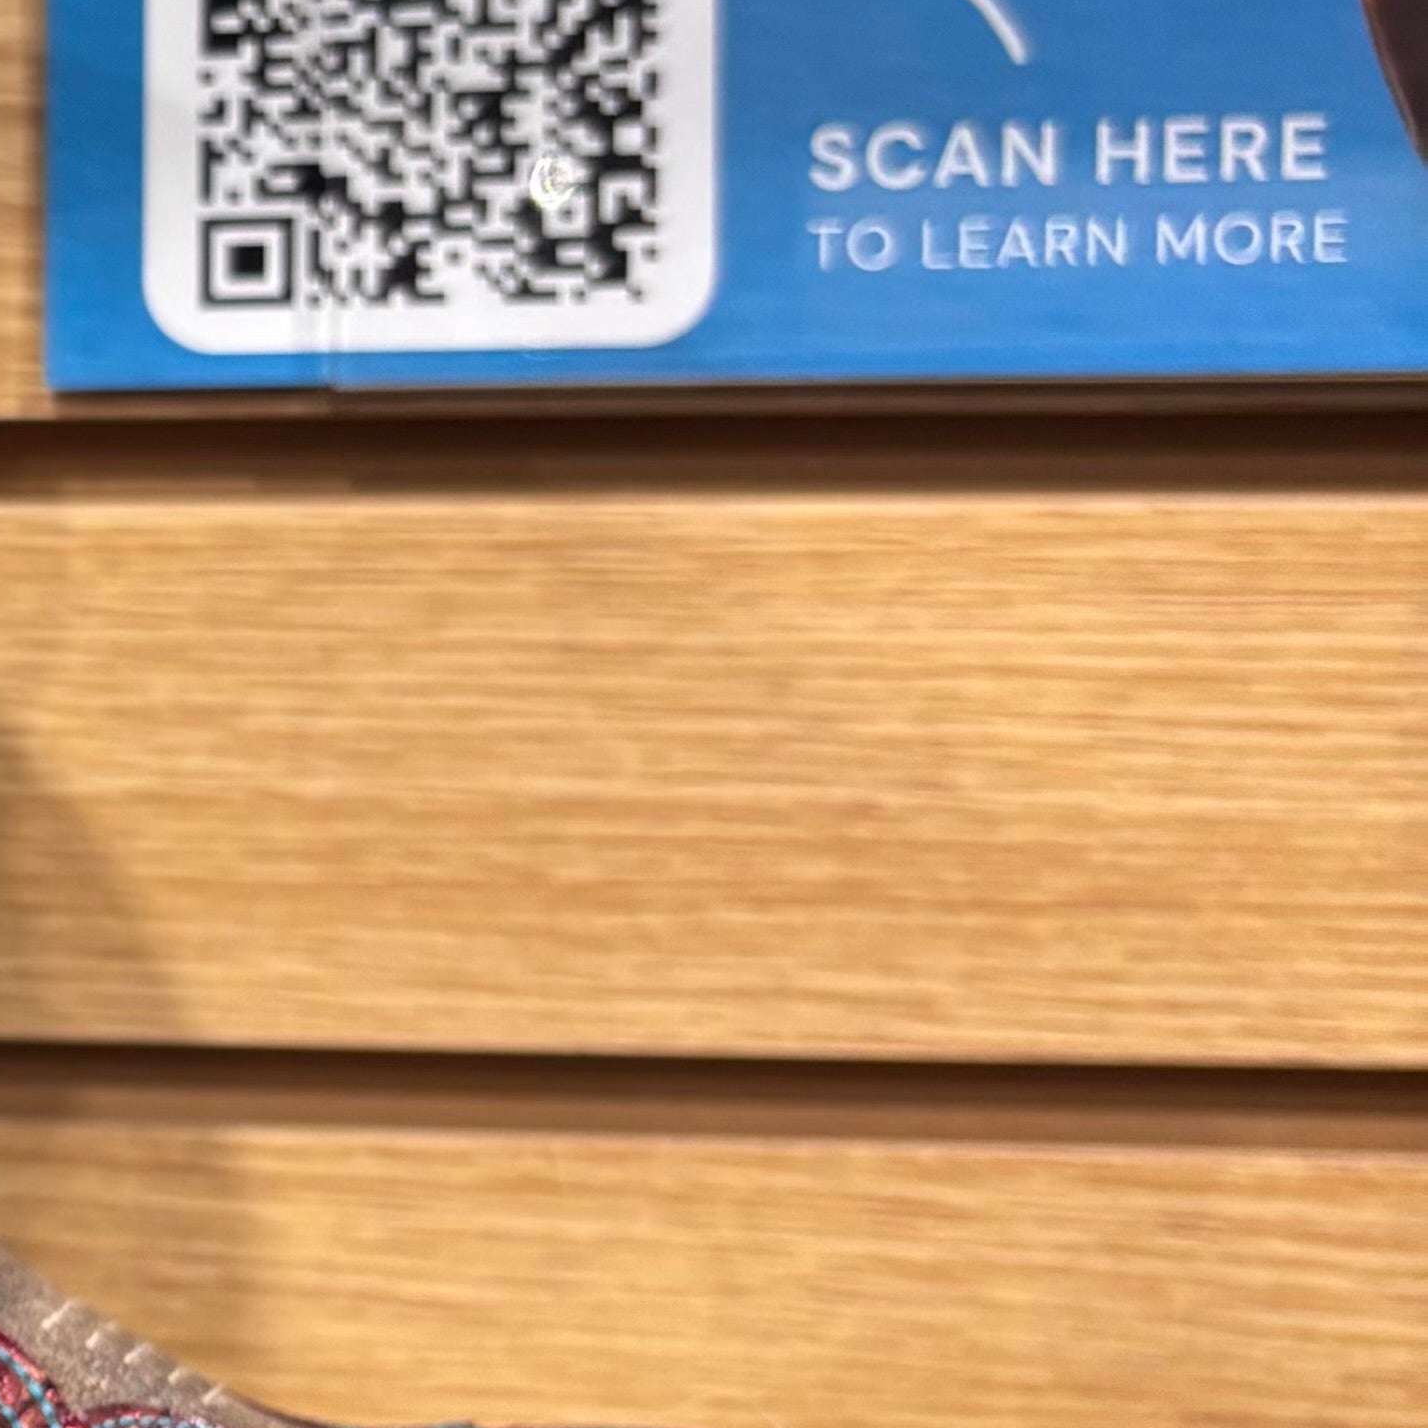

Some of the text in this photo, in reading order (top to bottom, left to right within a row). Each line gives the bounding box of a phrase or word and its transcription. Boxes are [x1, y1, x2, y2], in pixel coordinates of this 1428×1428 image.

[809, 112, 1327, 192] SCAN HERE
[807, 210, 1348, 273] TO LEARN MORE
